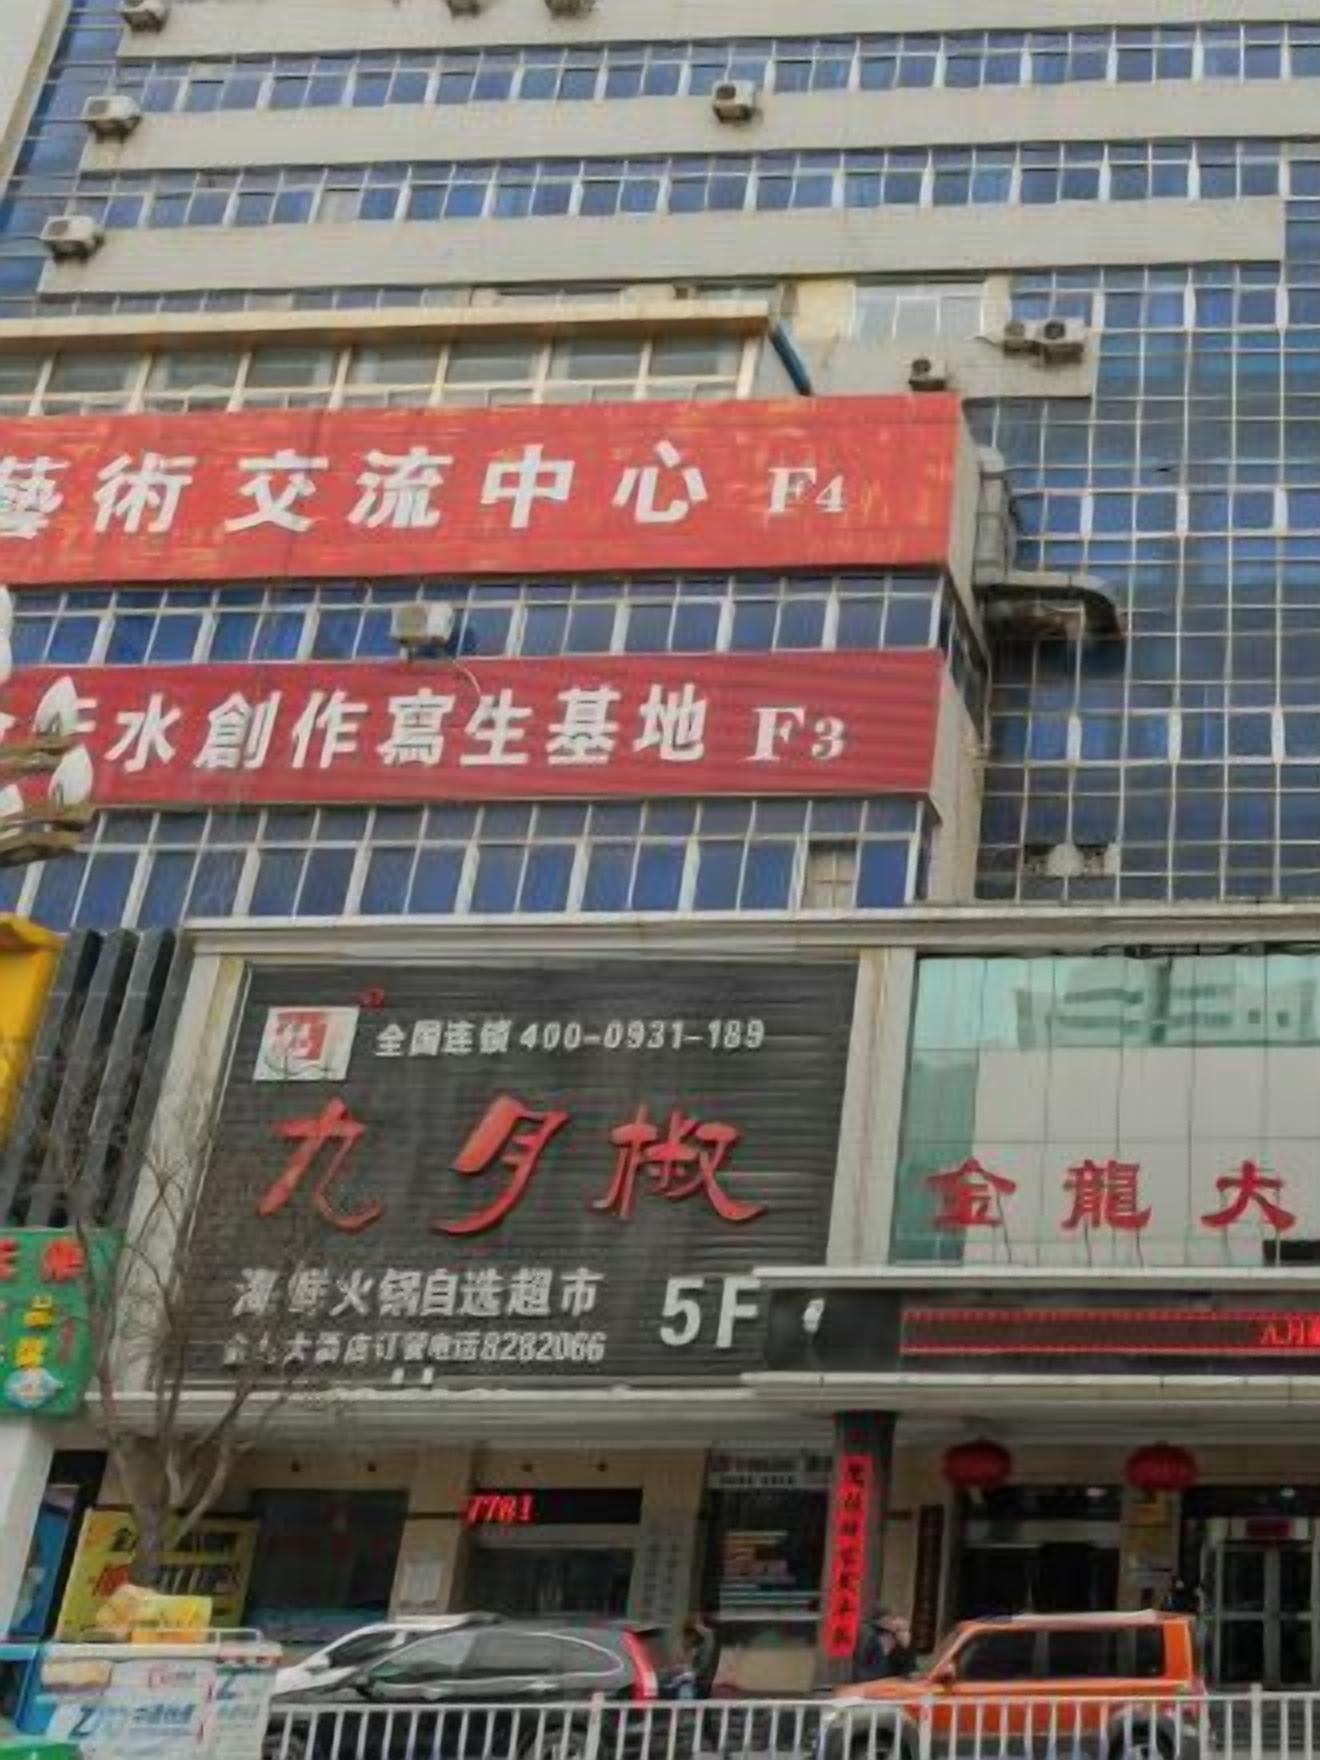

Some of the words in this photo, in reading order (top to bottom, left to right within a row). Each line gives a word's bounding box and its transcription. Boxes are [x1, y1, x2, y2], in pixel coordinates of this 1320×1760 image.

[767, 466, 844, 514] F4
[746, 706, 846, 763] F3
[519, 1018, 765, 1053] 400-0931-189
[660, 1275, 762, 1348] 5F
